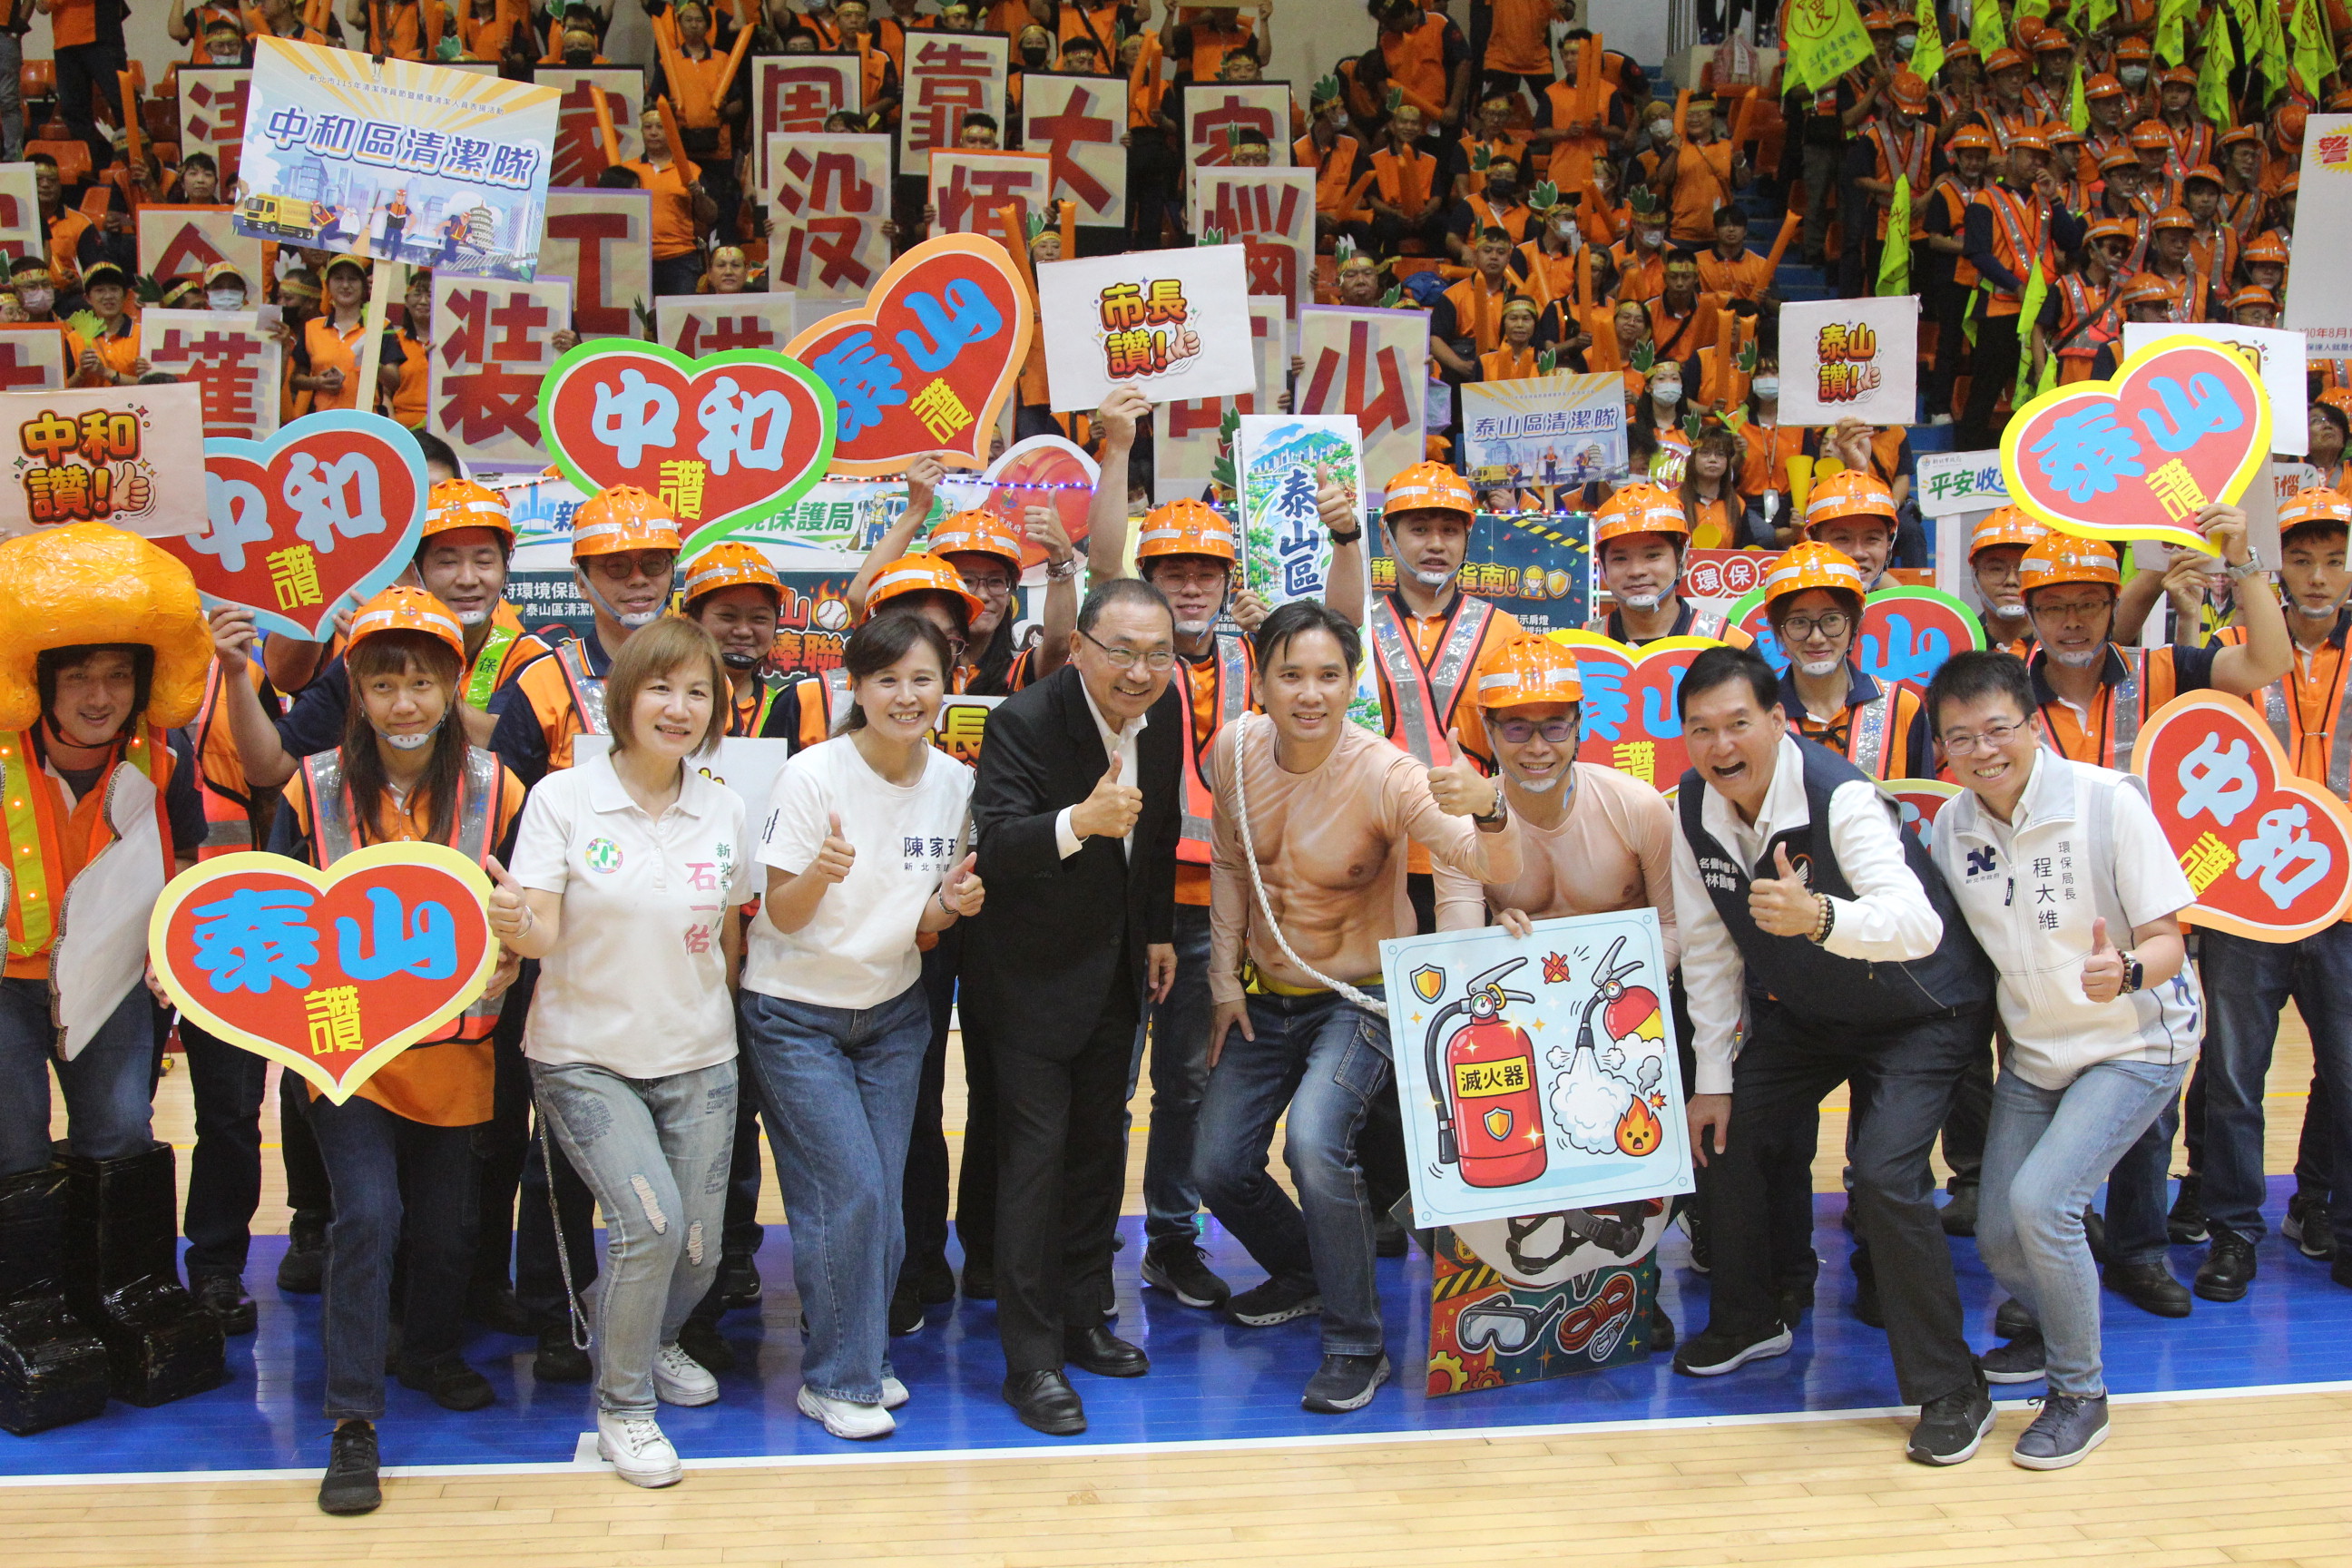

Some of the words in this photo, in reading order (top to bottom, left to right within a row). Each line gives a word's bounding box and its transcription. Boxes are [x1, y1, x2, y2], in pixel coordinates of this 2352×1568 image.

[267, 104, 537, 187] 中和區清潔隊
[549, 80, 629, 188] 家
[1029, 84, 1114, 214] 大
[546, 212, 630, 335] 工
[1100, 279, 1188, 332] 市長
[439, 288, 548, 447] 裝
[813, 278, 1004, 443] 泰山
[1104, 328, 1168, 378] 讚!
[1818, 322, 1877, 366] 泰山
[909, 377, 975, 445] 讚
[1818, 363, 1859, 403] 讚!
[19, 408, 142, 466] 中和
[592, 368, 792, 475] 中和
[1475, 406, 1620, 441] 泰山區清潔隊
[2029, 371, 2244, 504] 泰山
[23, 465, 113, 524] 讚!
[184, 451, 388, 573] 中和
[658, 459, 707, 521] 讚
[2144, 457, 2210, 524] 讚
[1275, 468, 1324, 597] 泰山區
[266, 544, 324, 612] 讚
[479, 657, 497, 673] 保
[2176, 730, 2332, 910] 中和
[1965, 873, 2000, 885] 新北市政府
[2033, 857, 2060, 931] 程大維
[2057, 840, 2077, 901] 環保局長
[191, 886, 458, 994] 泰山
[682, 862, 720, 956] 石一佑
[303, 985, 364, 1056] 讚
[1461, 1063, 1526, 1093] 滅火器
